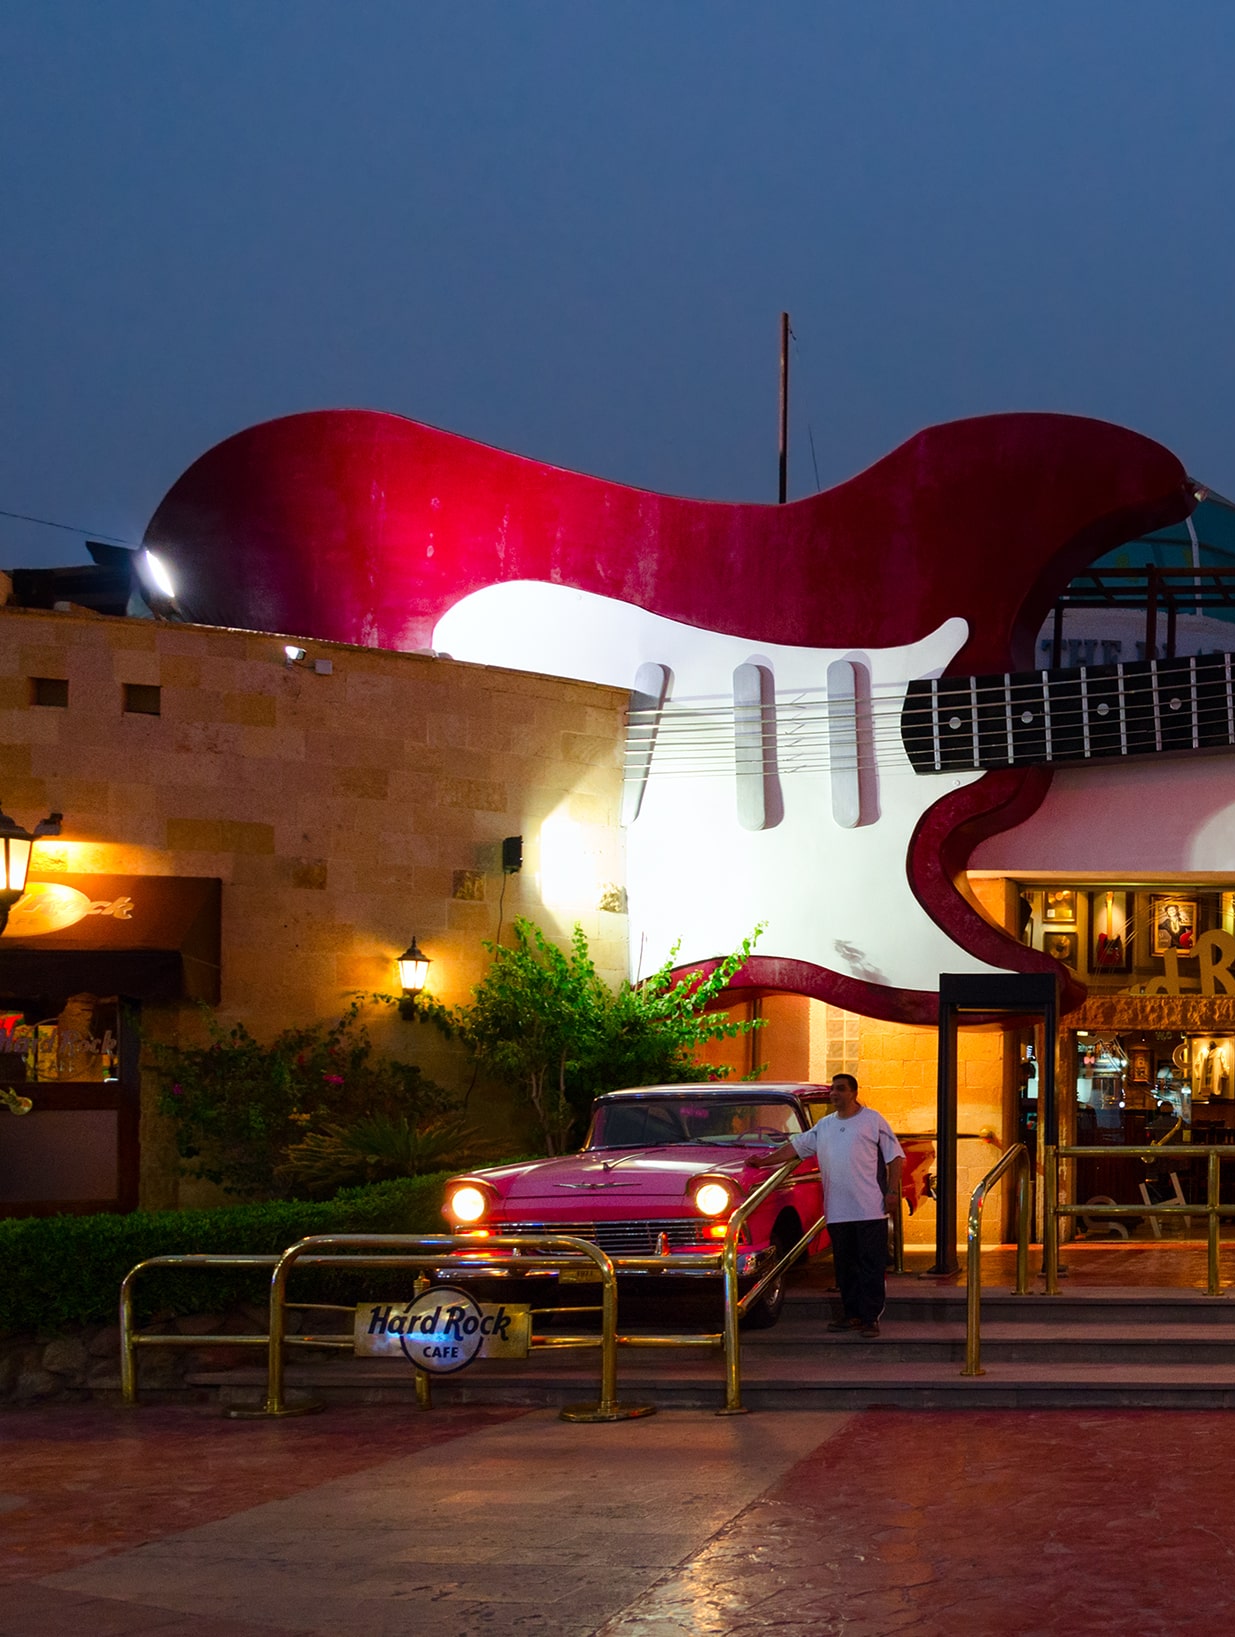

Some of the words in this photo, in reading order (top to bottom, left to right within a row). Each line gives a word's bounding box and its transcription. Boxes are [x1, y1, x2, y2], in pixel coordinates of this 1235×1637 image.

[368, 1306, 443, 1336] Hard
[443, 1306, 512, 1342] Rock
[423, 1346, 459, 1359] CAFE
